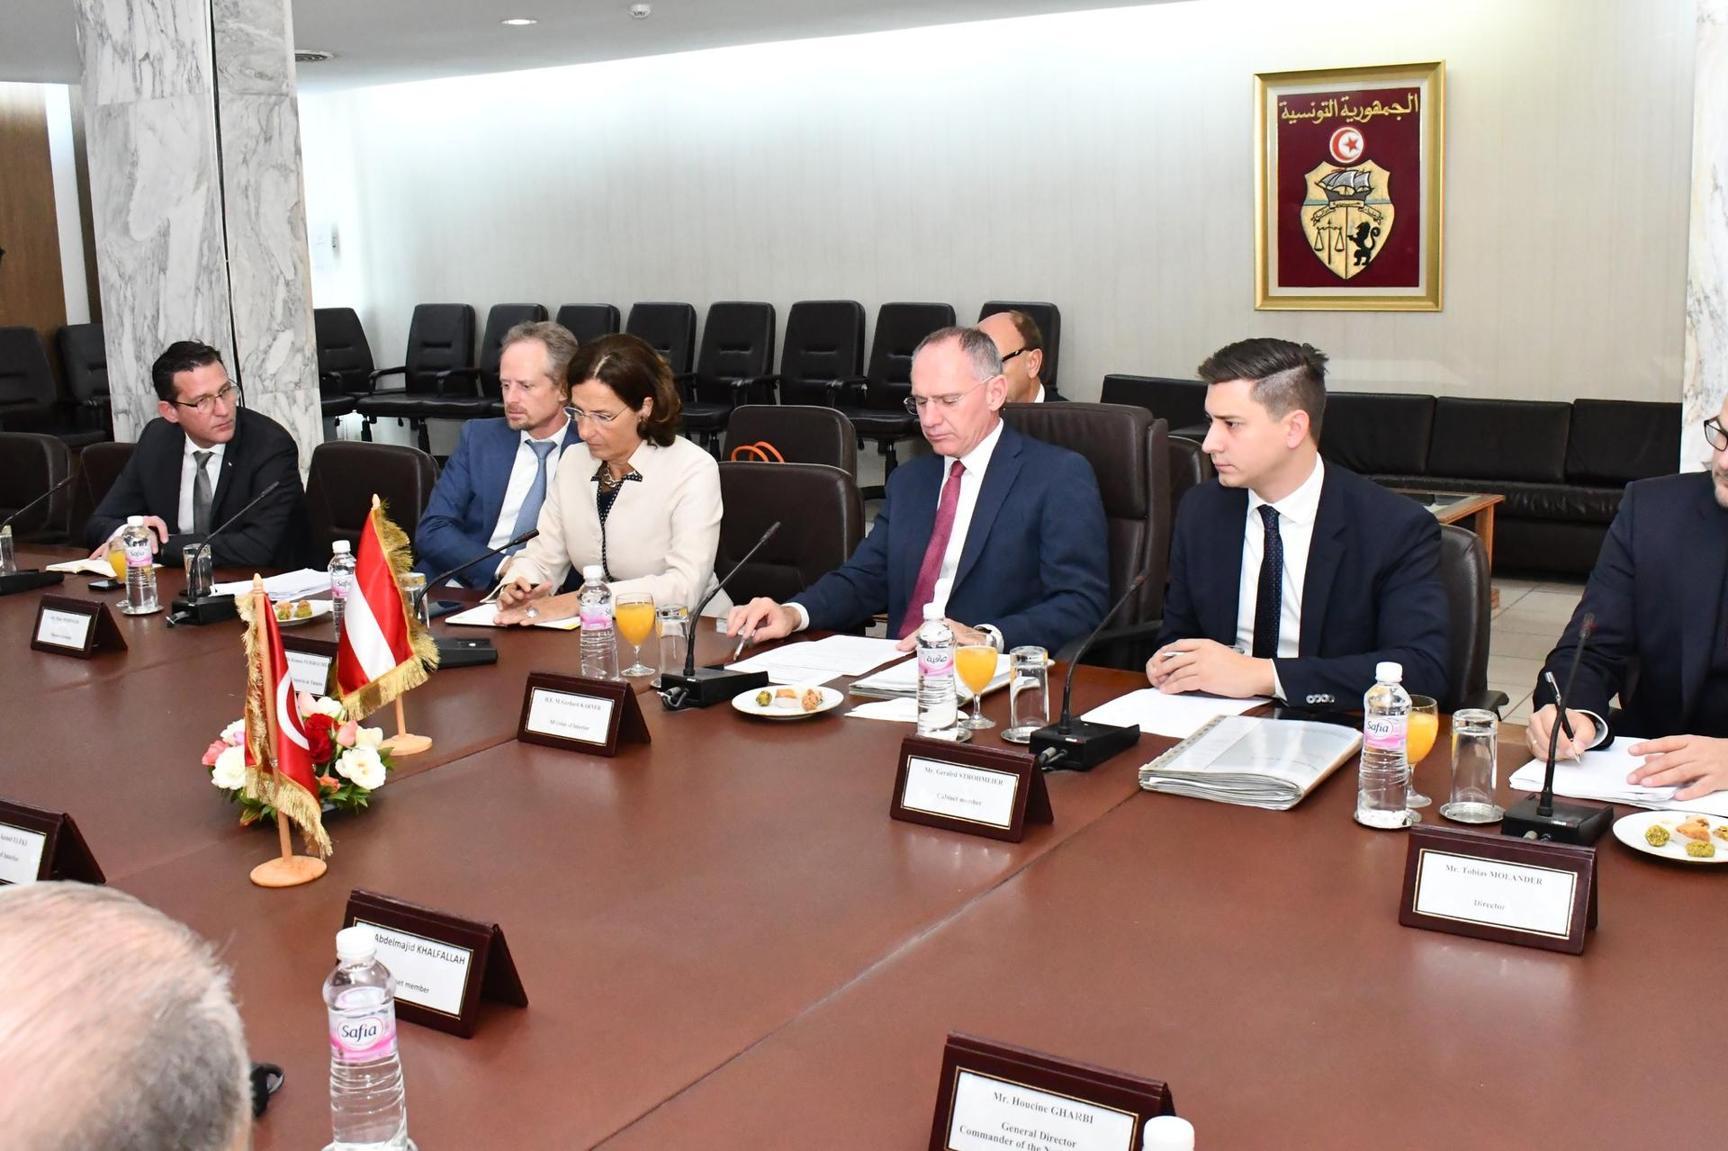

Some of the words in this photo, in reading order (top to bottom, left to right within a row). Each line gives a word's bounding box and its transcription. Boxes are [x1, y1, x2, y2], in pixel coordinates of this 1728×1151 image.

[1279, 99, 1339, 124] التونسية
[1340, 92, 1419, 123] الجمهورية
[1367, 720, 1389, 734] Safia
[1445, 864, 1459, 873] Mr.
[1462, 866, 1487, 877] Tobias
[1489, 870, 1543, 886] MOLANDER
[1473, 899, 1505, 911] Director
[416, 946, 466, 965] KHALFALLAH
[341, 1024, 377, 1042] Safia
[993, 1091, 1009, 1104] Mr.
[1012, 1096, 1049, 1113] Houcine
[1050, 1106, 1094, 1125] GHARBI
[959, 1125, 1013, 1146] Commander
[1015, 1140, 1025, 1149] of
[1001, 1121, 1037, 1138] General
[1039, 1130, 1077, 1148] Director
